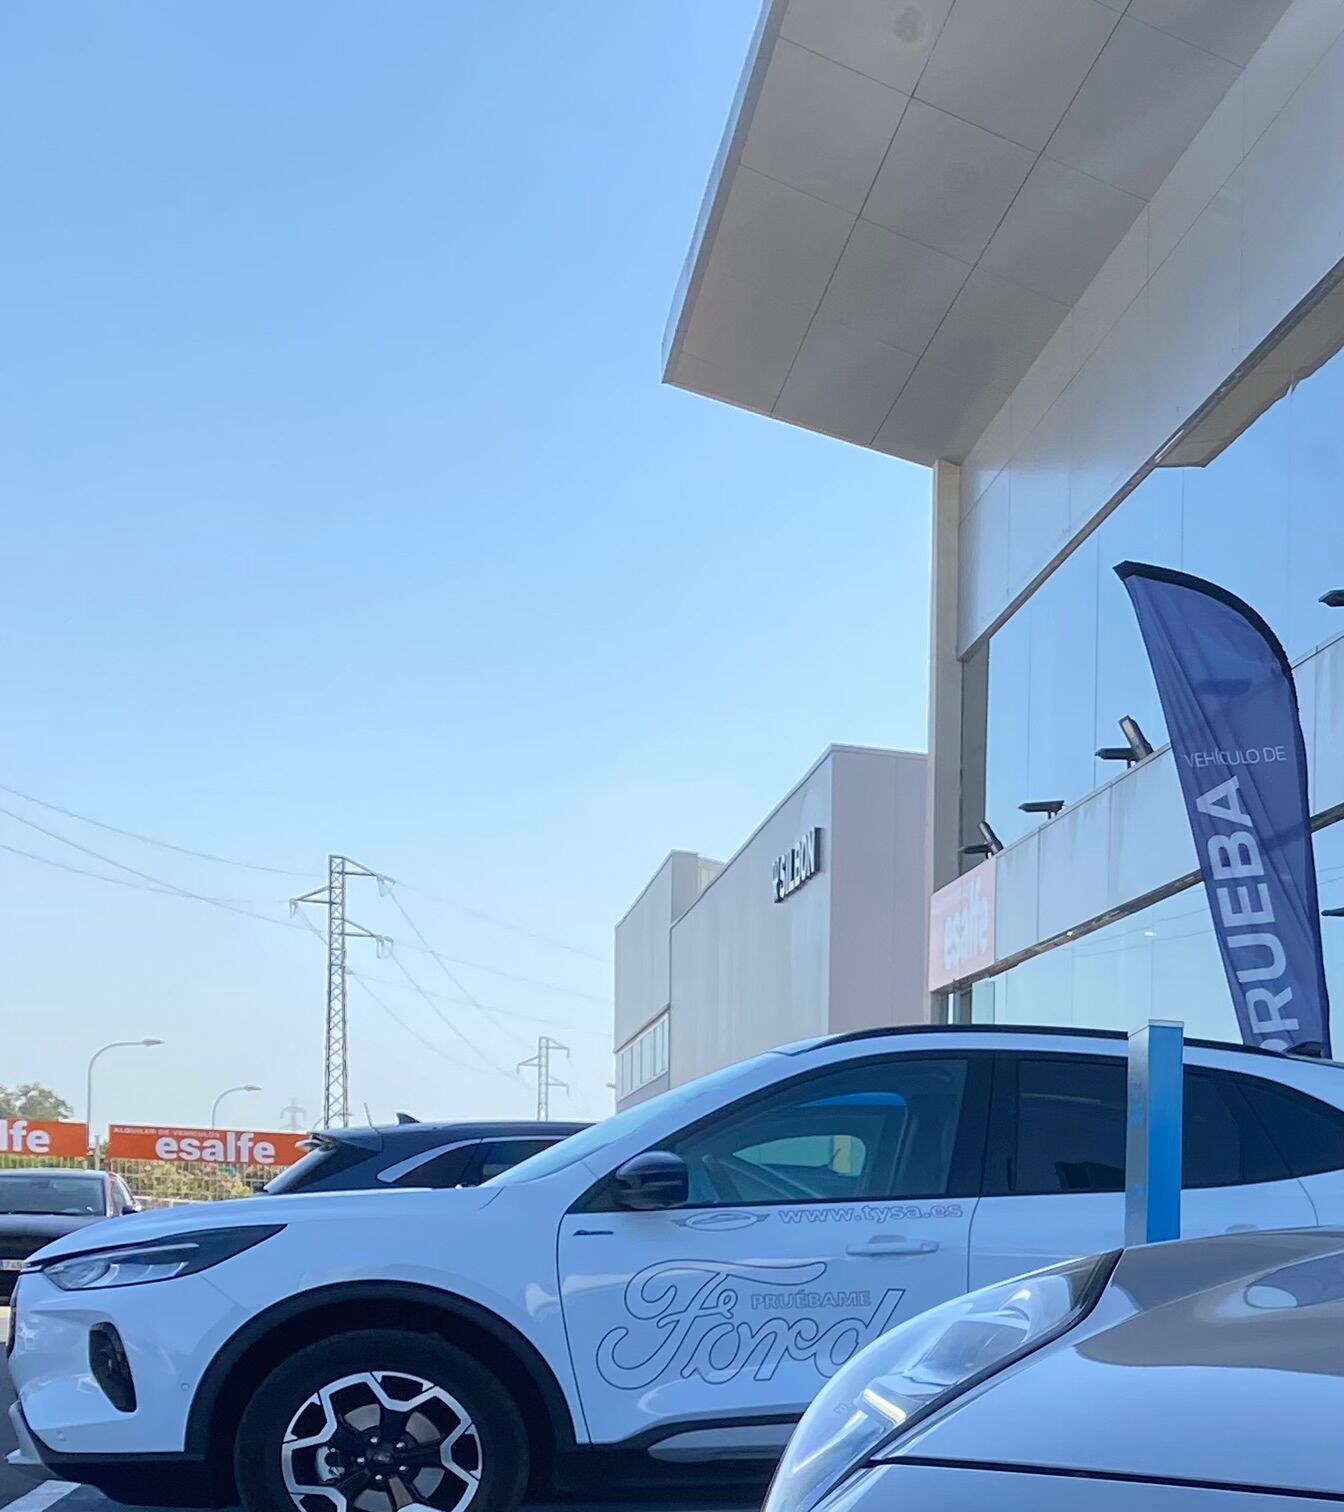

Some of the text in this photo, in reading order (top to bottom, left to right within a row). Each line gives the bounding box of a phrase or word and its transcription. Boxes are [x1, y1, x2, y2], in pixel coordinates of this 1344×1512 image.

[1183, 745, 1287, 768] VEHÍCULO DE
[155, 1132, 275, 1164] esalfe
[778, 1204, 963, 1224] www.tysa.es
[751, 1289, 872, 1310] PRUÉBAME
[596, 1259, 905, 1390] Ford
